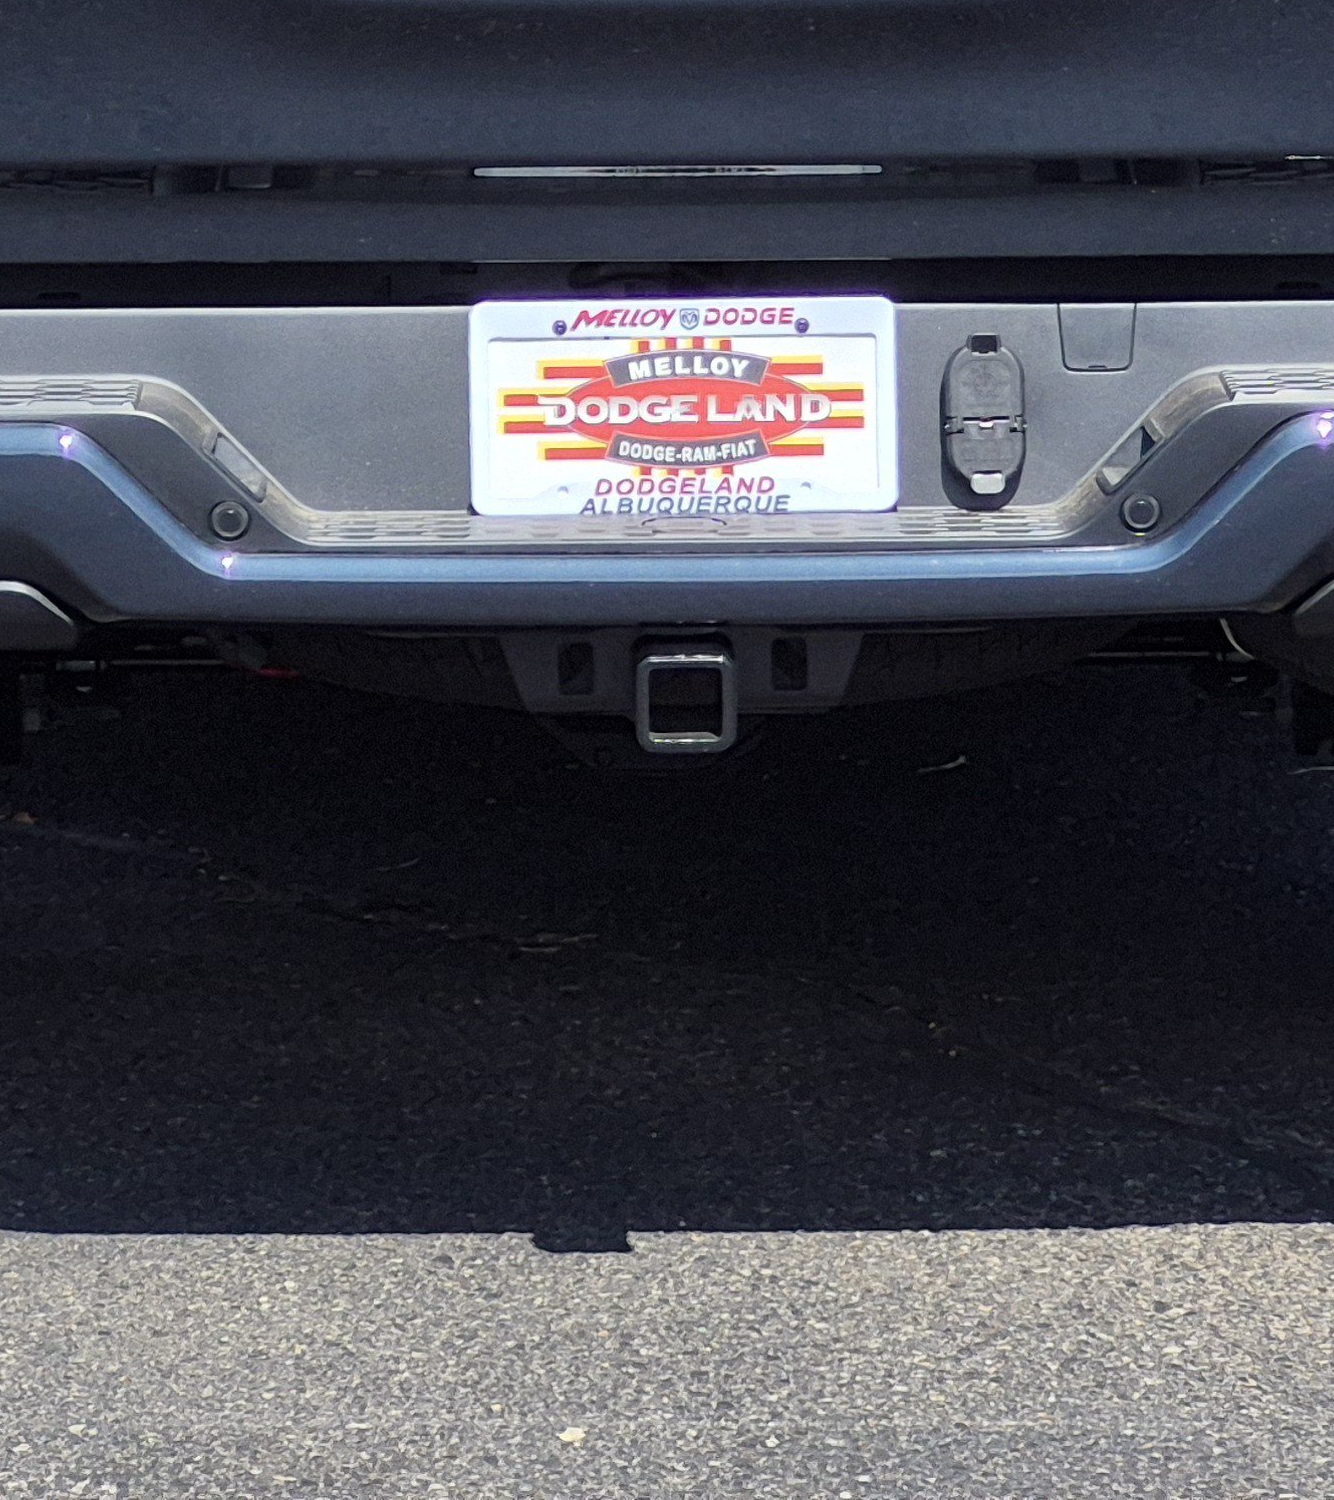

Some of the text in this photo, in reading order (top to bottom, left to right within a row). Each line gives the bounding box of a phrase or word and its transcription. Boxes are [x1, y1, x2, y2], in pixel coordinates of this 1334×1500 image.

[570, 307, 795, 331] MELLOY DODGE
[628, 355, 750, 381] MELLOY
[537, 393, 833, 426] DODGE LAND
[618, 438, 757, 463] DODGE-RAM-FIAT
[595, 475, 776, 497] DODGELAND
[579, 494, 791, 515] ALBUQUERQUE
